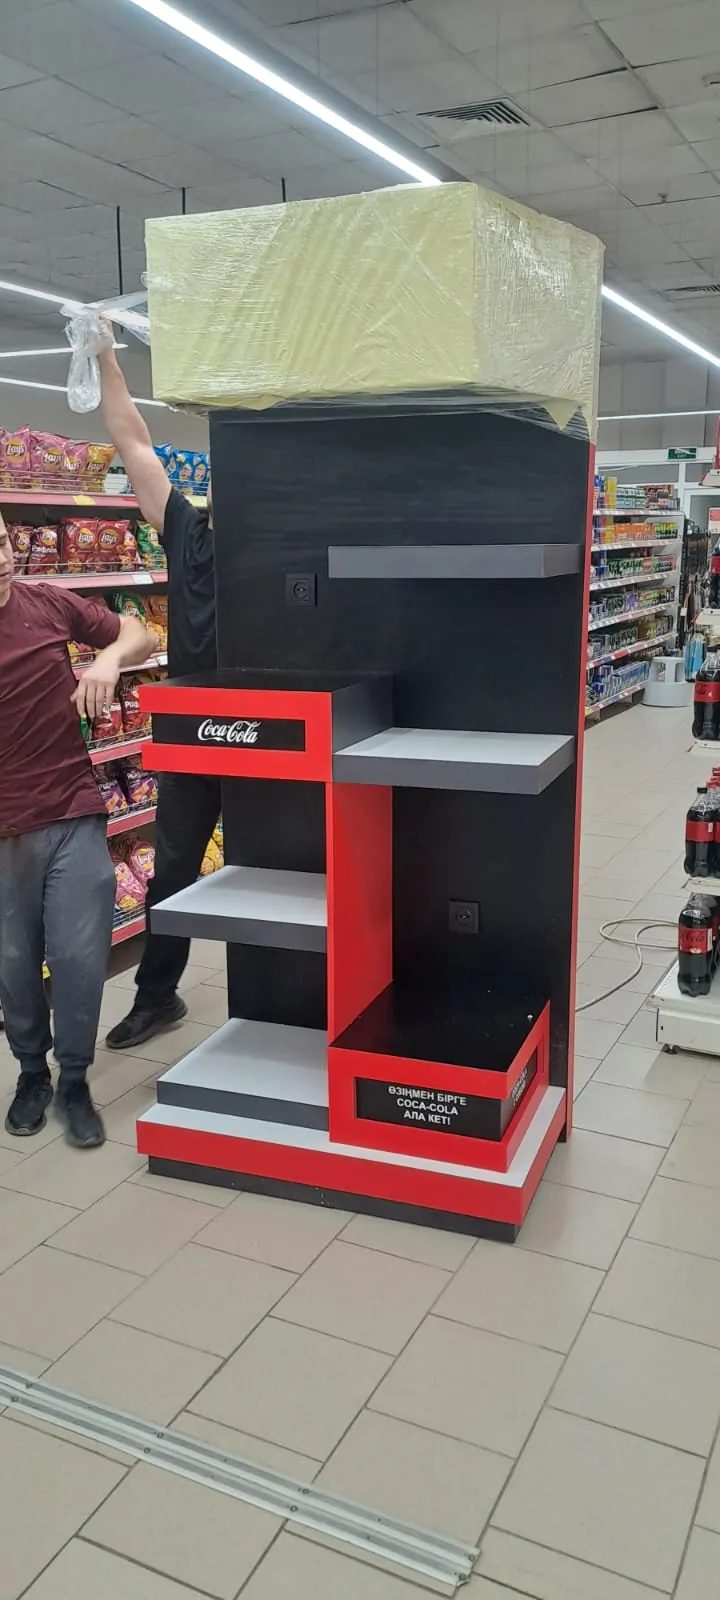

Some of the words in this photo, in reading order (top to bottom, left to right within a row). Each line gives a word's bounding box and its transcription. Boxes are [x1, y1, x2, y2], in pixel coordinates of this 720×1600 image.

[197, 718, 262, 744] Coca-Cola
[388, 1085, 435, 1101] ӨЗІҢМЕН
[437, 1092, 468, 1106] БІРГЕ
[396, 1097, 459, 1116] COCA-COLA
[403, 1110, 426, 1122] АЛА
[428, 1113, 451, 1126] КЕТ!
